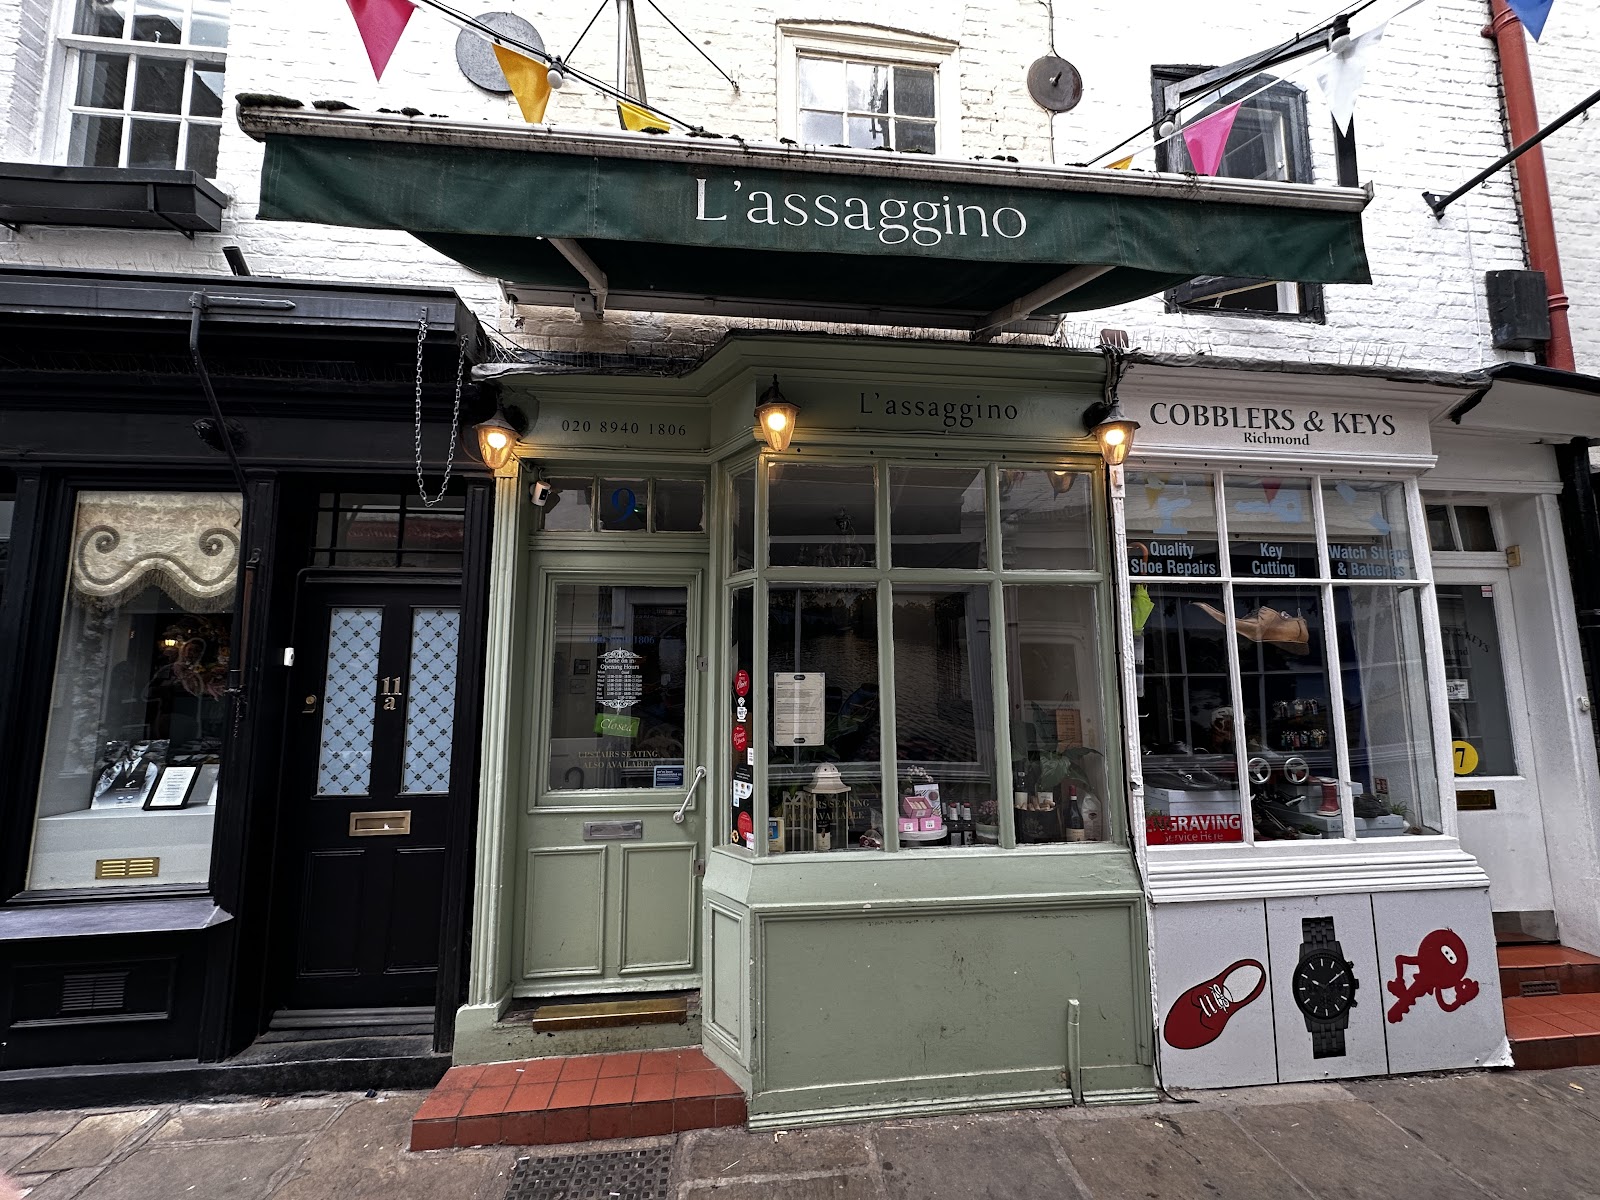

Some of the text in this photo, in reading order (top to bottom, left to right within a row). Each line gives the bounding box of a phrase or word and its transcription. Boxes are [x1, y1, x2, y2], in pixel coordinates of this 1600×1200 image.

[695, 178, 1027, 247] L'assaggino
[860, 392, 1018, 428] L'assaggino
[1149, 402, 1396, 436] COBBLERS & KEYS
[561, 419, 686, 436] 020 8940 1806
[1243, 432, 1310, 446] Richmond
[611, 487, 636, 523] 9
[1149, 541, 1195, 560] Quality
[1260, 542, 1283, 560] Key
[1328, 545, 1368, 560] Watch
[1130, 558, 1217, 577] Shoe Repairs
[1251, 560, 1296, 578] Cutting
[1337, 562, 1405, 577] & Batteries
[380, 676, 402, 696] 11
[383, 696, 397, 711] a
[600, 718, 633, 732] Closed
[578, 750, 658, 759] UPSTAIRS SEATING
[1455, 747, 1466, 768] 7
[583, 760, 654, 769] ALSO AVAILABLE
[1164, 831, 1224, 843] Service Here
